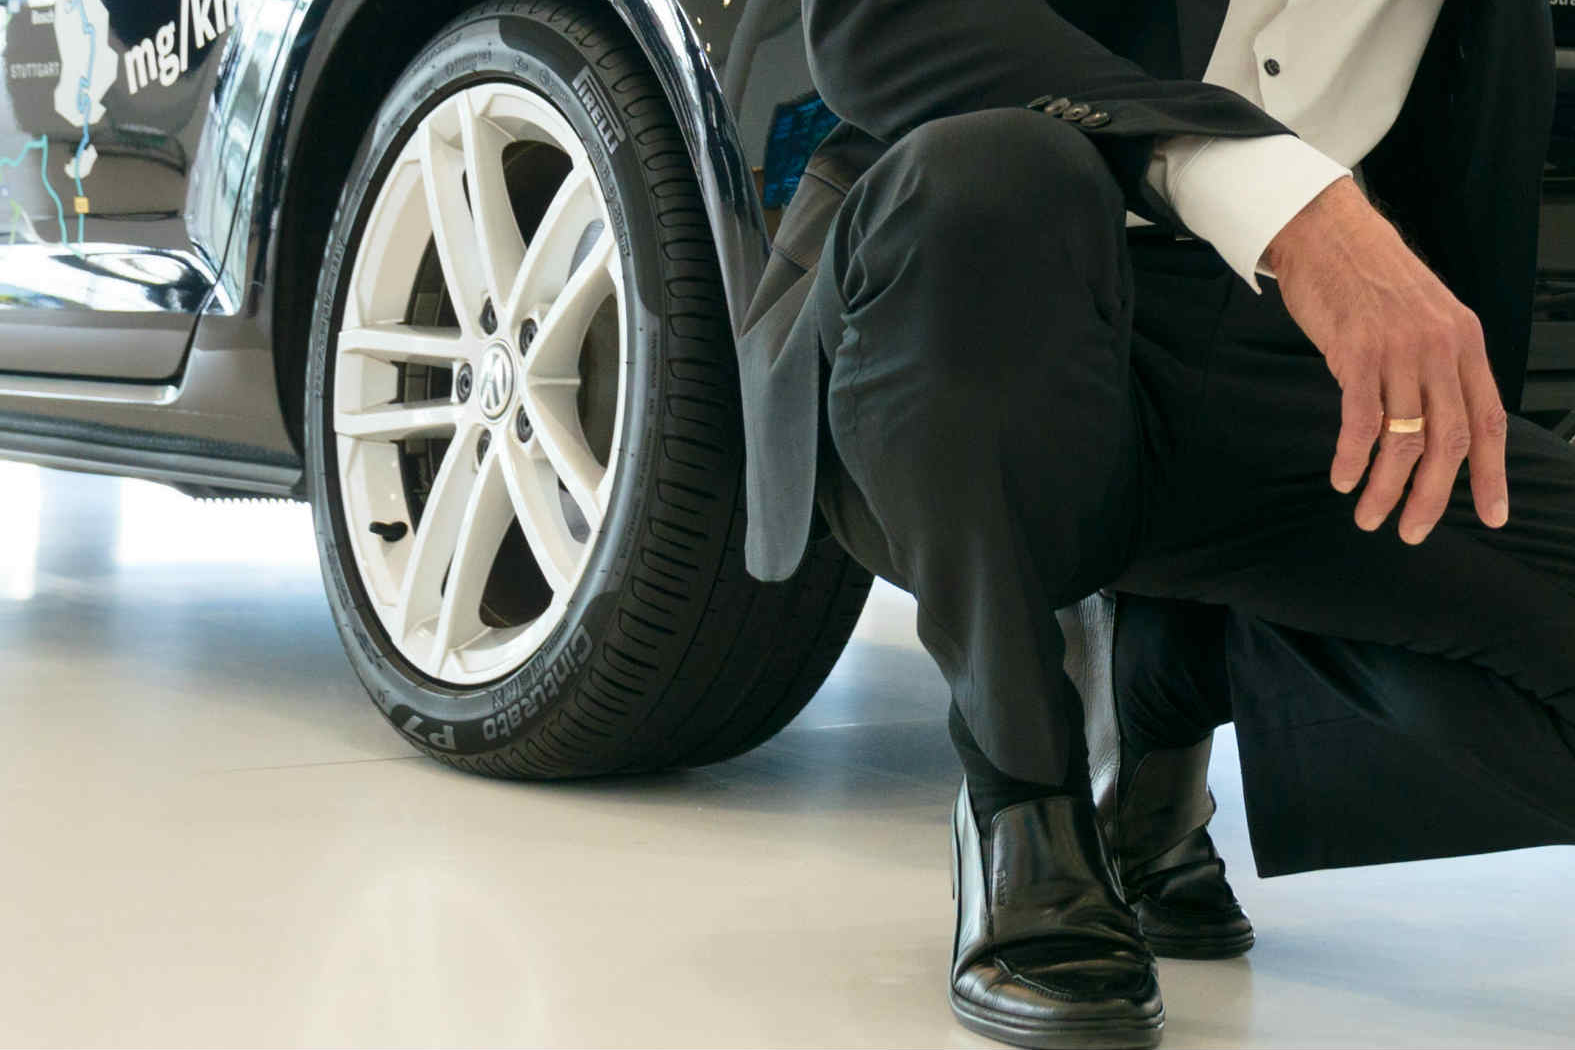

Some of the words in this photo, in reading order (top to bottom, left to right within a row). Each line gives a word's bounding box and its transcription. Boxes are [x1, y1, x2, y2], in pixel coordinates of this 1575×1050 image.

[572, 65, 627, 155] PIRELLI
[482, 625, 593, 741] Cinturato
[401, 715, 457, 750] P7
